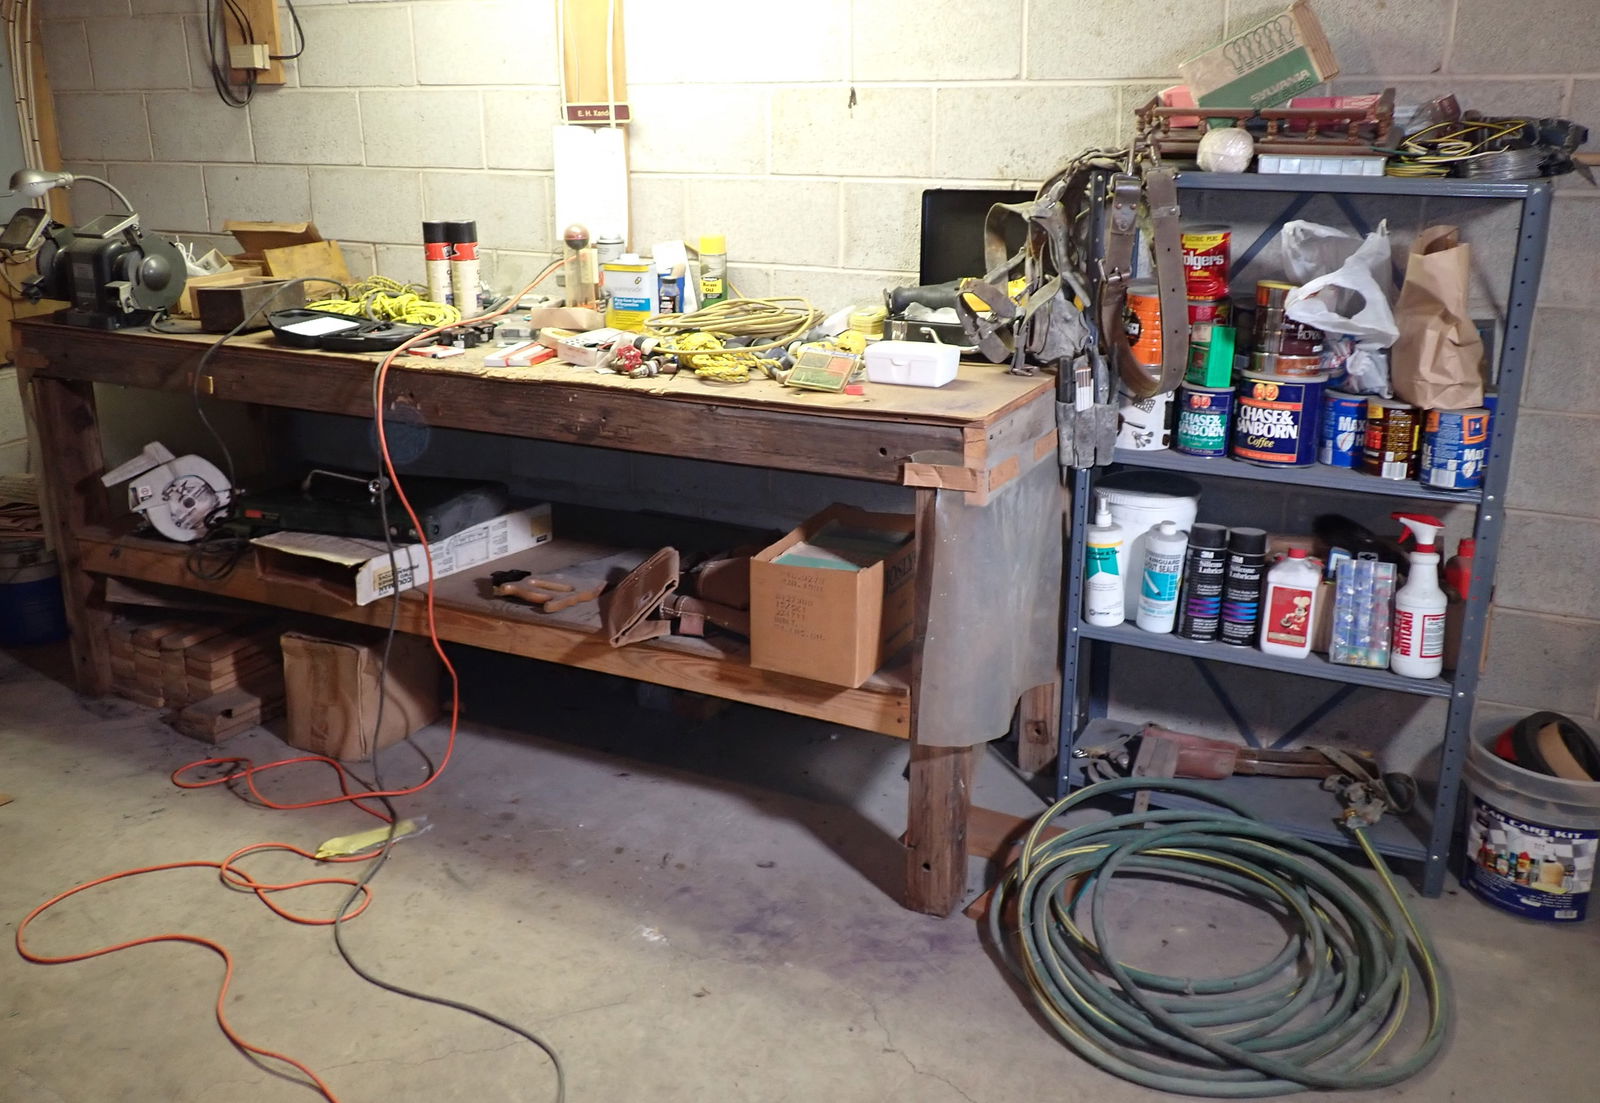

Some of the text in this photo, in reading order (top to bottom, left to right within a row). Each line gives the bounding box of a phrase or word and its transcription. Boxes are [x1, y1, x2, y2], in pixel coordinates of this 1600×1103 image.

[1181, 249, 1225, 271] olgers
[1237, 417, 1298, 439] SANBORN
[1337, 416, 1367, 432] MAX
[1247, 435, 1275, 448] Coffee
[1399, 611, 1414, 657] RUTLAND
[1482, 804, 1582, 839] CAR CARE KIT
